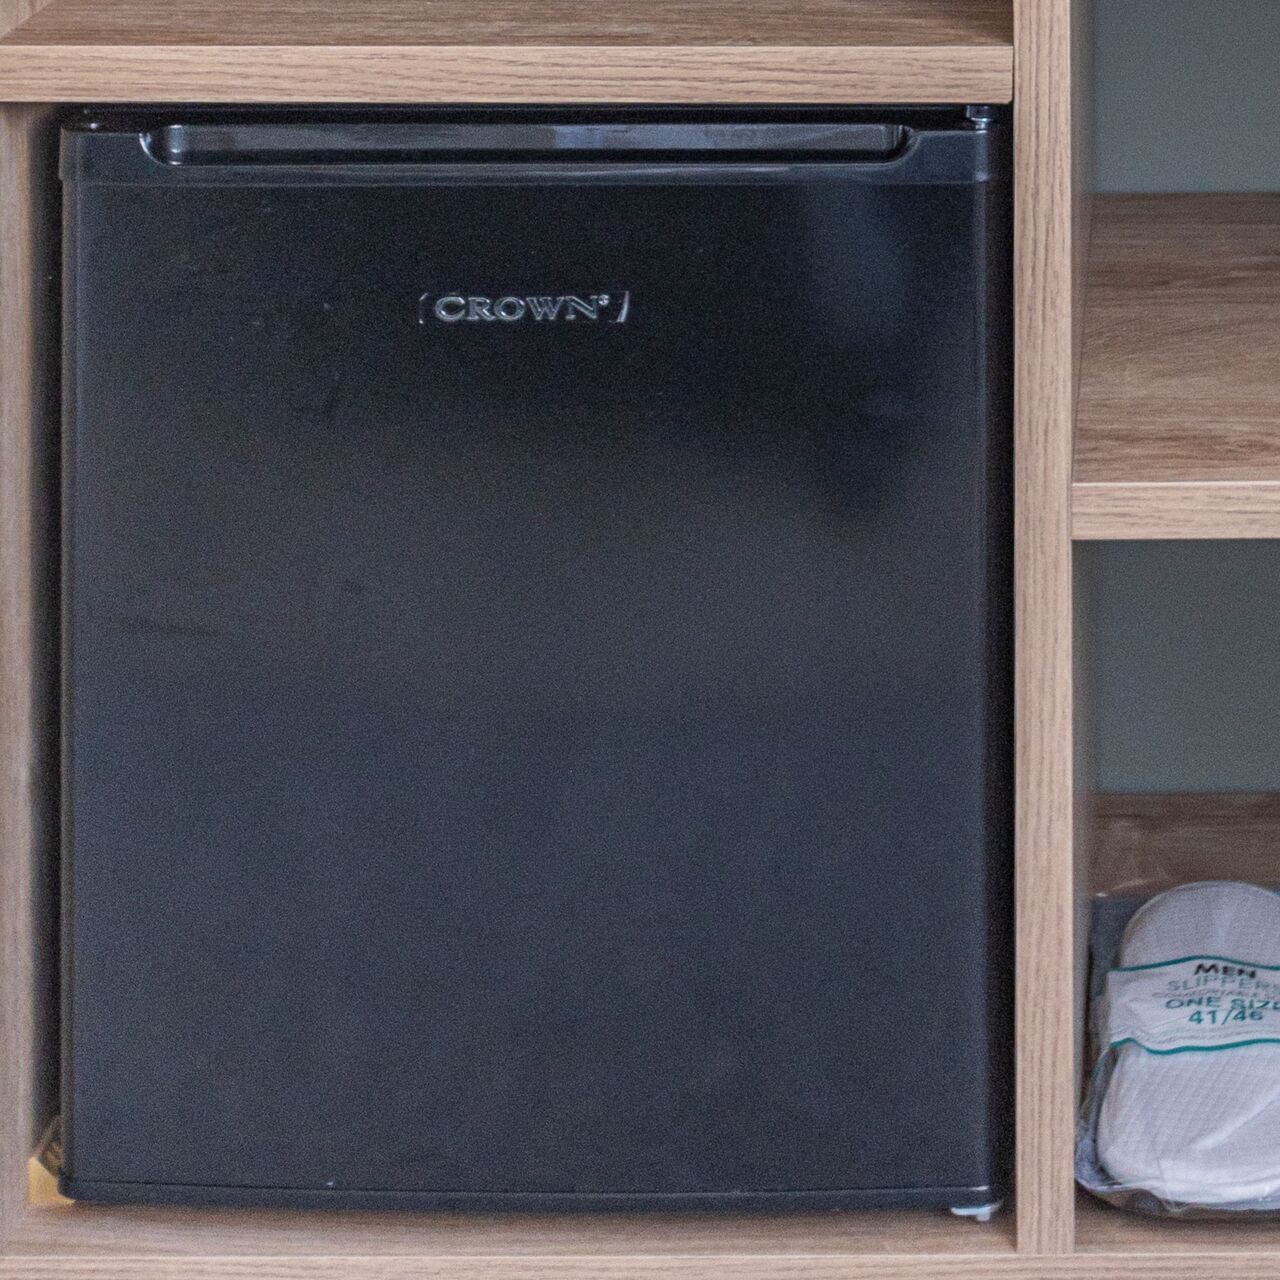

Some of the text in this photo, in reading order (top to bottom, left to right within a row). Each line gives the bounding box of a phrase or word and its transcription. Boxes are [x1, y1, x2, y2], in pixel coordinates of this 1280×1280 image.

[434, 295, 600, 322] CROWN
[1194, 963, 1257, 979] MEN
[1165, 996, 1222, 1010] ONE
[1188, 1009, 1264, 1026] 41/46
